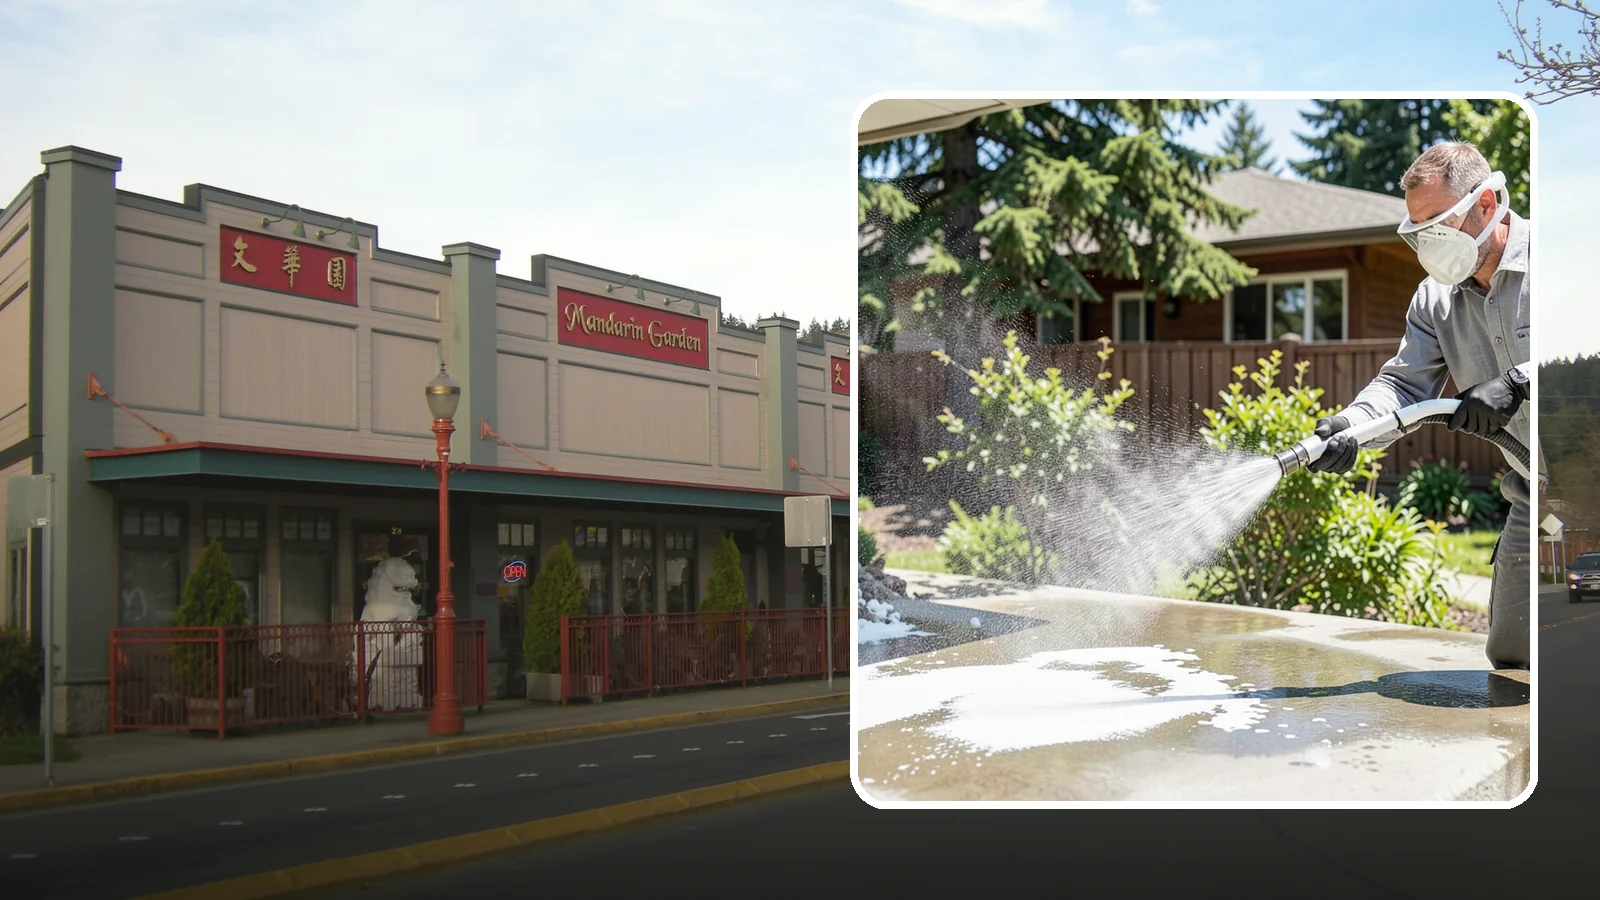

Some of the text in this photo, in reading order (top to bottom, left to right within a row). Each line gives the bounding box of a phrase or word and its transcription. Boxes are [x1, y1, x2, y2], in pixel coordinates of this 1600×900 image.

[230, 236, 345, 290] 文華園
[564, 302, 701, 351] Mandarin Garden
[834, 363, 846, 386] 文
[503, 565, 527, 578] OPEN
